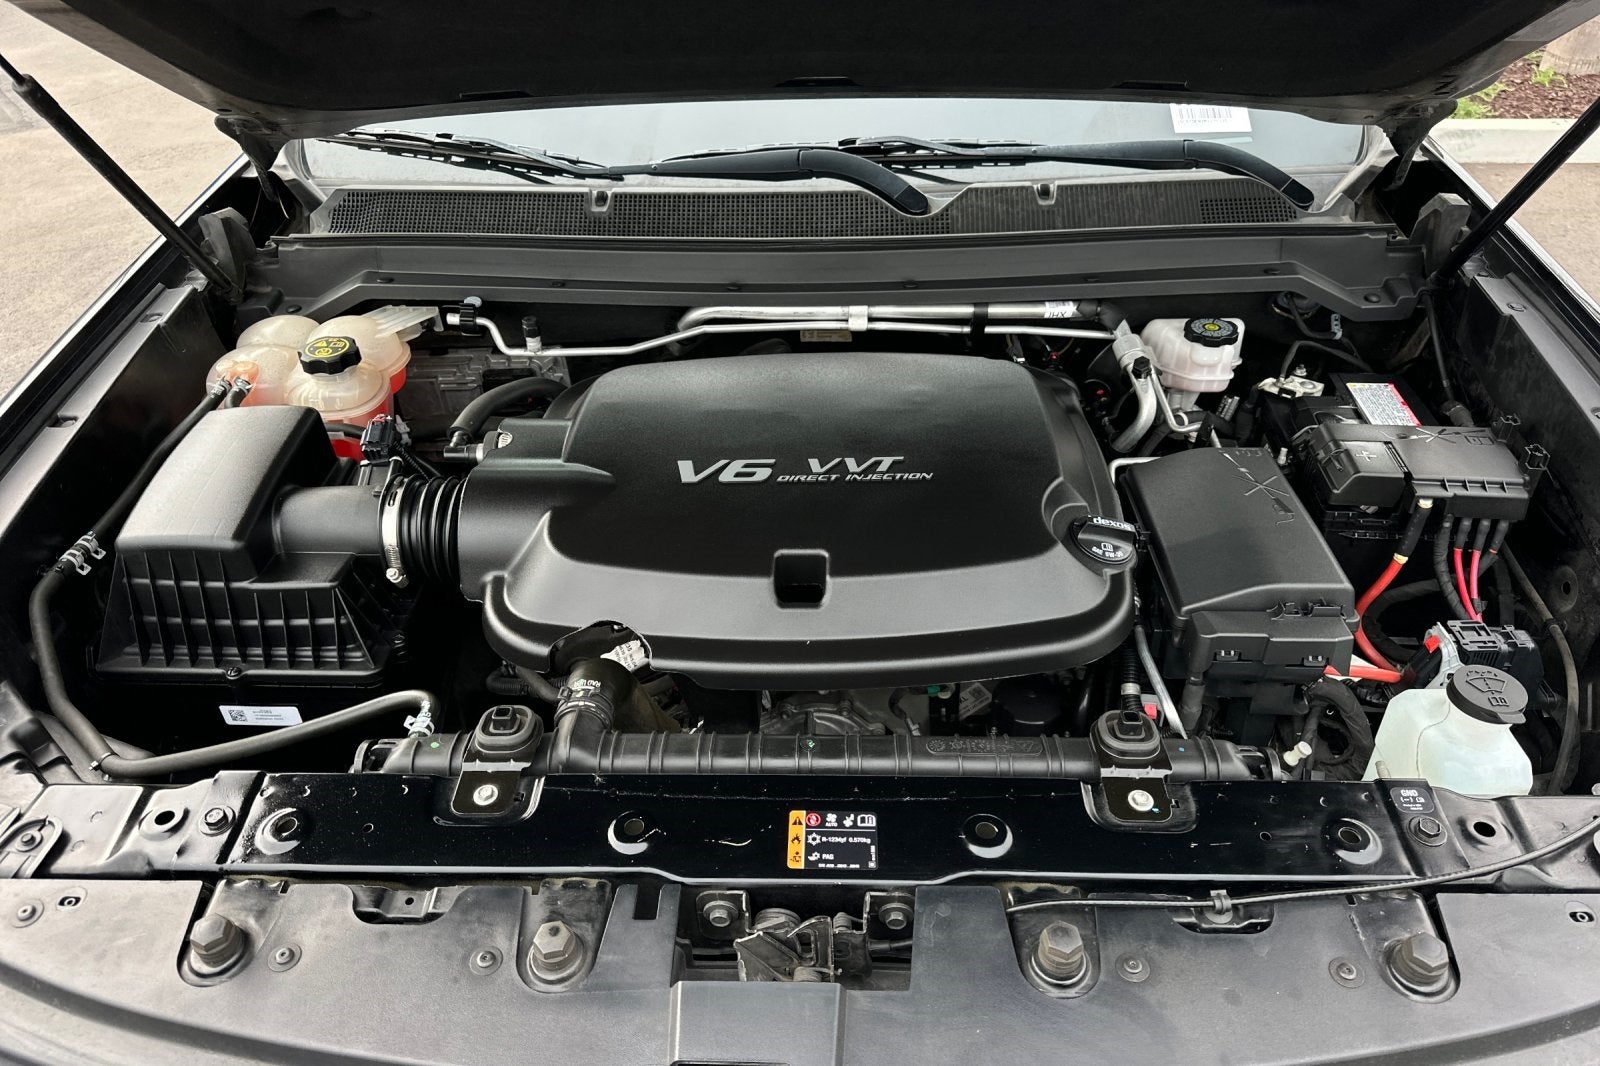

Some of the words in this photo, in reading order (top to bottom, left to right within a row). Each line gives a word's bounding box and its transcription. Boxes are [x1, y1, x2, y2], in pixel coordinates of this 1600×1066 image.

[677, 458, 776, 483] V6
[807, 456, 904, 473] VVT
[776, 474, 841, 483] DIRECT
[845, 472, 934, 482] INJECTION
[1400, 789, 1418, 797] GND
